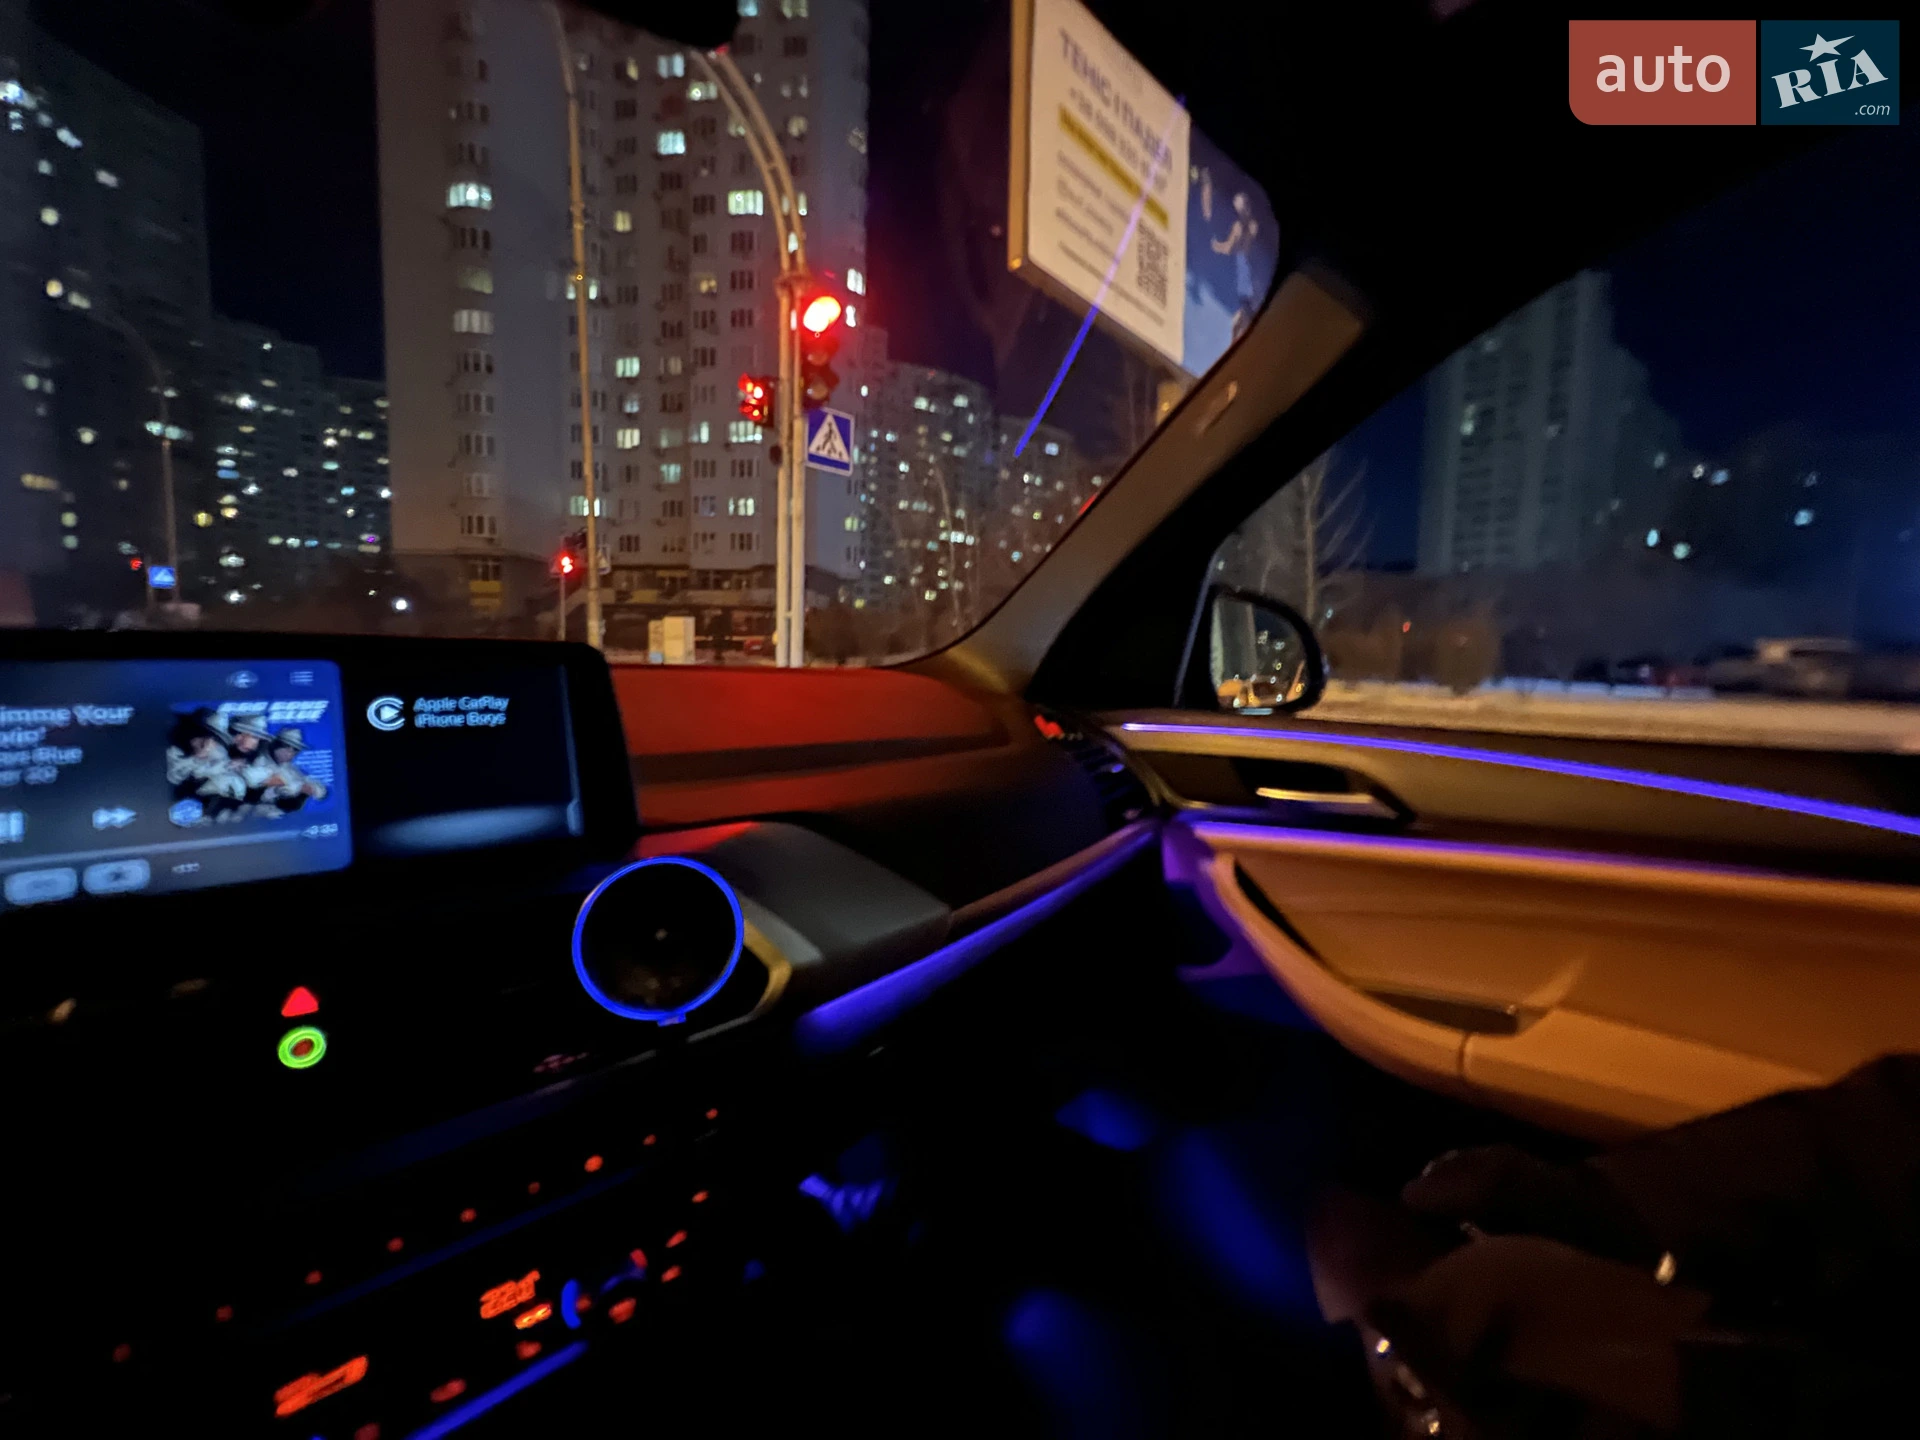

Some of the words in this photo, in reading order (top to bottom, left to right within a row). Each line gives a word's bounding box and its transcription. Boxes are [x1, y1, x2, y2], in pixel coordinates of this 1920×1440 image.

[413, 697, 457, 713] Apple
[458, 695, 509, 712] CarPlay
[72, 703, 135, 726] Your
